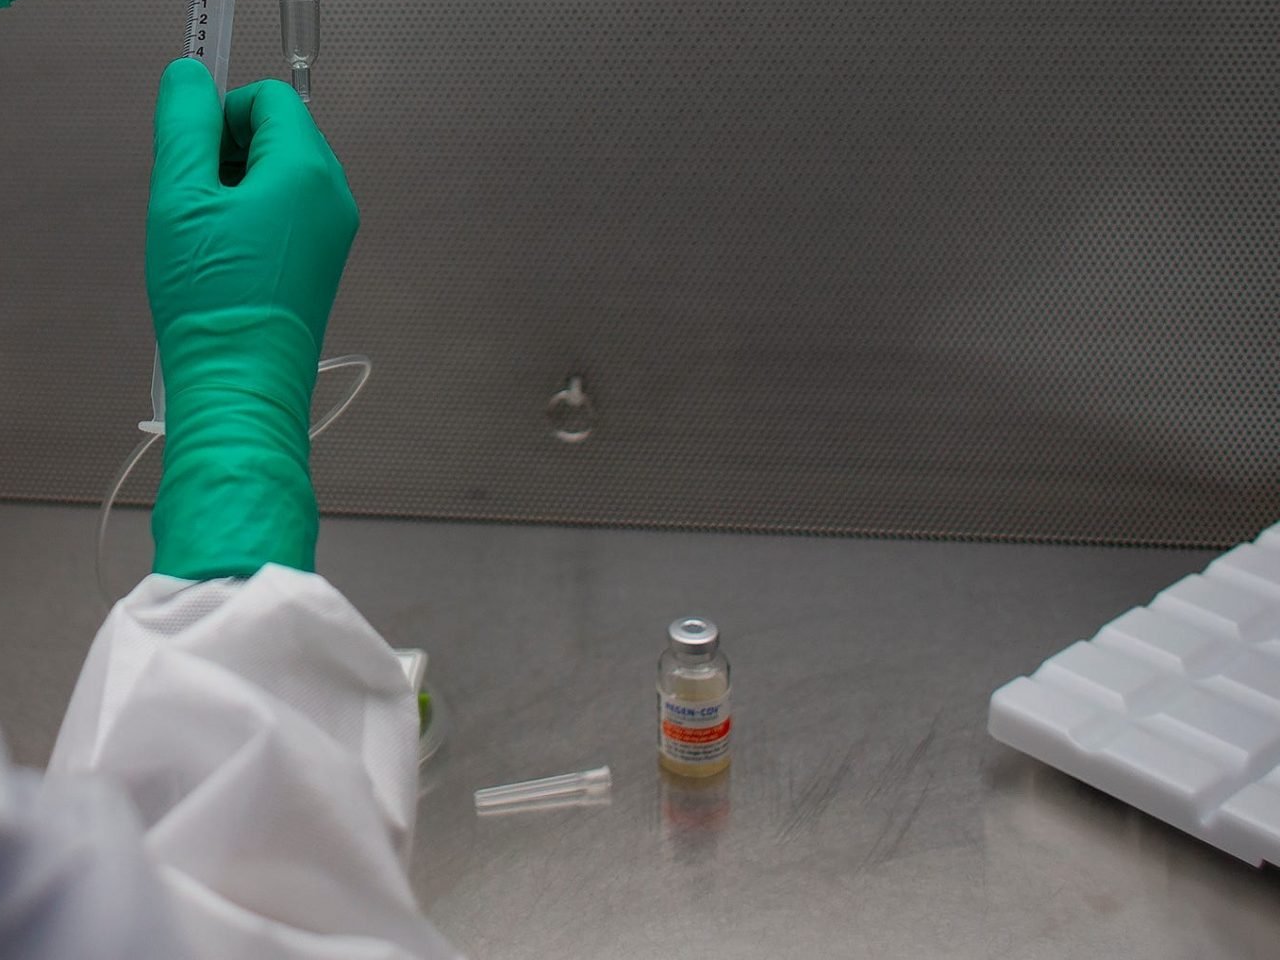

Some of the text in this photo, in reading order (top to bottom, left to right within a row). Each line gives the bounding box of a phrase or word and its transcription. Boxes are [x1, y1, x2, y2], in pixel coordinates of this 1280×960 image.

[199, 14, 208, 24] 2
[198, 30, 206, 41] 3
[196, 46, 204, 57] 4
